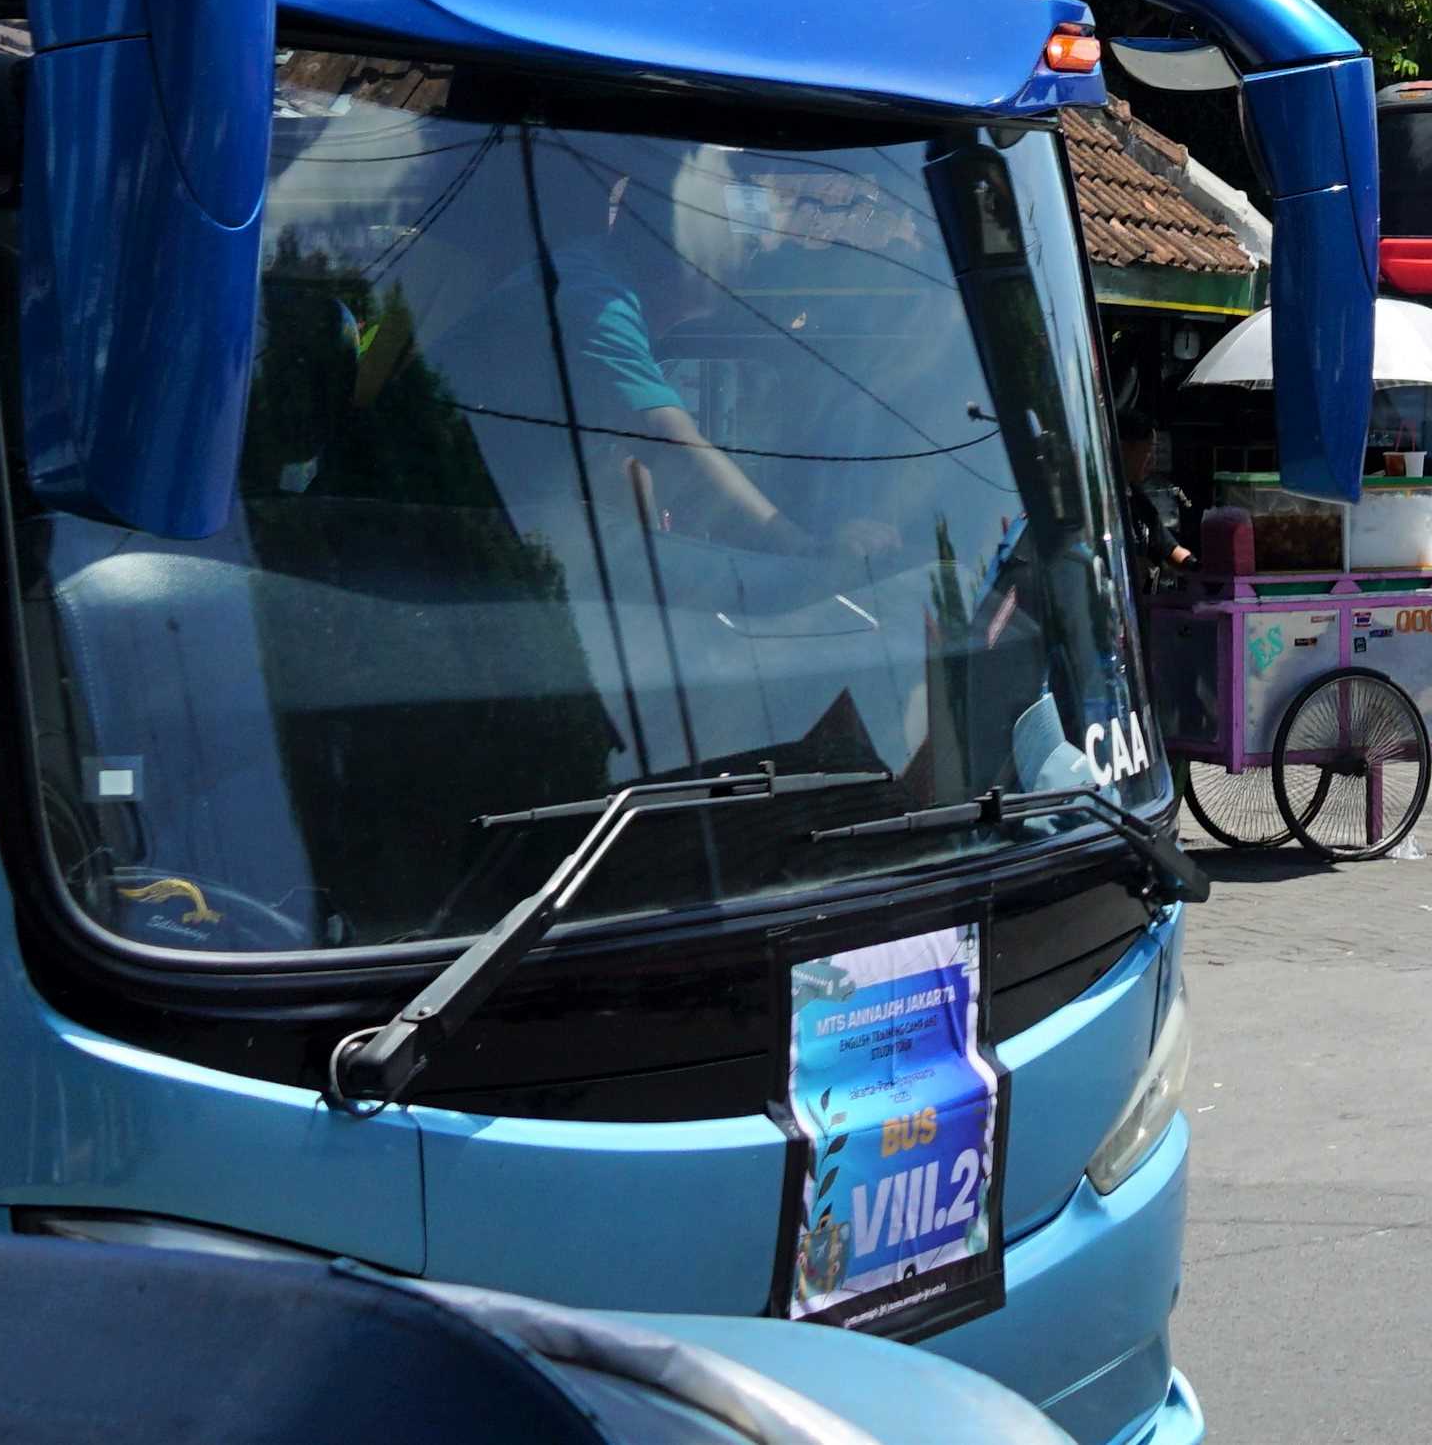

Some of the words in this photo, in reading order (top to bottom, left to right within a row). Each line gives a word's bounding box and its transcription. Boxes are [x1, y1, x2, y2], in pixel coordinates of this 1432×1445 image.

[1085, 710, 1150, 787] CAA
[816, 1013, 846, 1037] MTS
[906, 984, 957, 1015] JAKARTA
[881, 1105, 938, 1159] BUS
[852, 1148, 981, 1259] VIII.2
